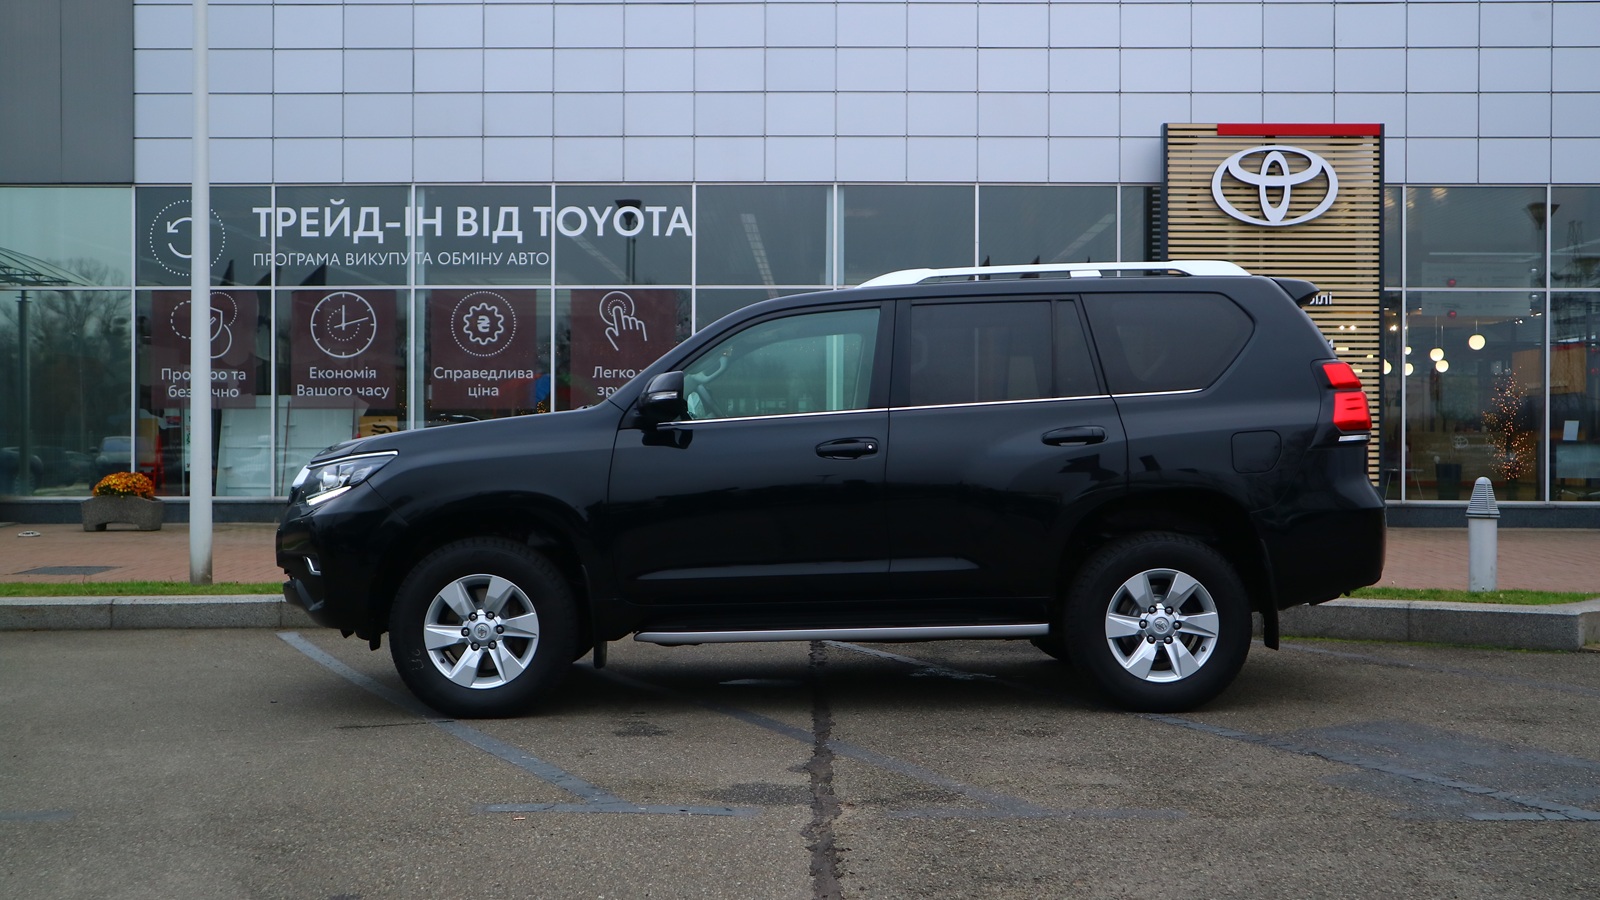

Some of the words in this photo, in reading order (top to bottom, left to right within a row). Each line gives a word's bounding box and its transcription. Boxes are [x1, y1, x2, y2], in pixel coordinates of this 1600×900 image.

[252, 198, 442, 244] ТРЕЙД-ІН
[456, 206, 523, 244] ВІД
[533, 206, 693, 237] TOYOTA
[253, 252, 341, 266] ПРОГРАМА
[345, 251, 410, 266] ВИКУПУ
[437, 251, 503, 265] ОБМІНУ
[506, 251, 550, 265] АВТО
[231, 371, 246, 380] та
[309, 367, 377, 379] Економія
[433, 367, 534, 380] Справедлива
[592, 366, 636, 378] Легко
[296, 385, 353, 397] Вашого
[356, 387, 390, 399] часу
[468, 385, 499, 397] ціна
